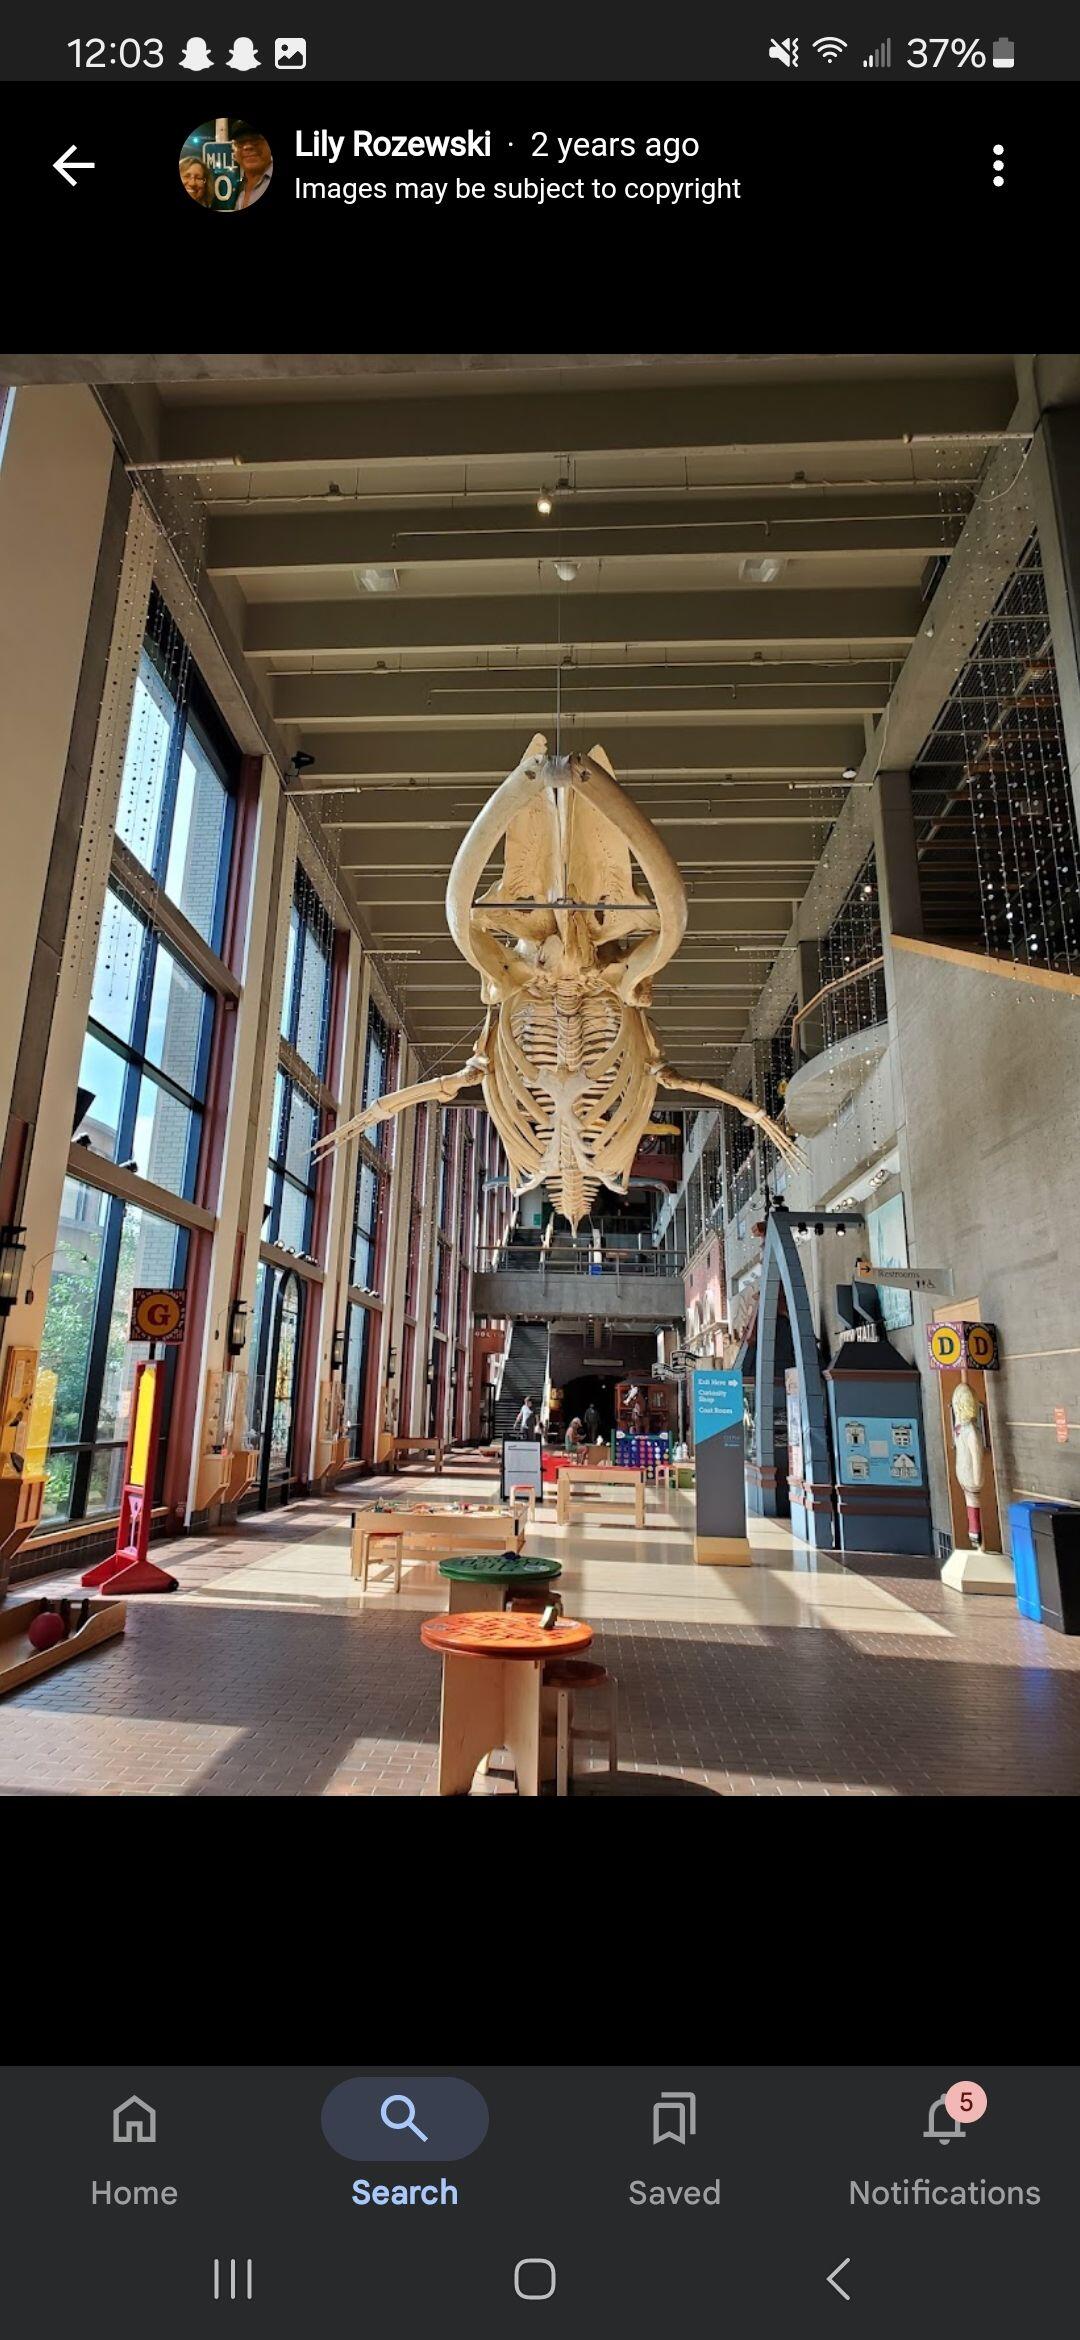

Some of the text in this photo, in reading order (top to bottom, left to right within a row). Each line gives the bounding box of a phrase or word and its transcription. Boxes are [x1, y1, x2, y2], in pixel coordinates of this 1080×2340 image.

[147, 1303, 171, 1326] G
[938, 1336, 955, 1356] D
[973, 1336, 989, 1356] D
